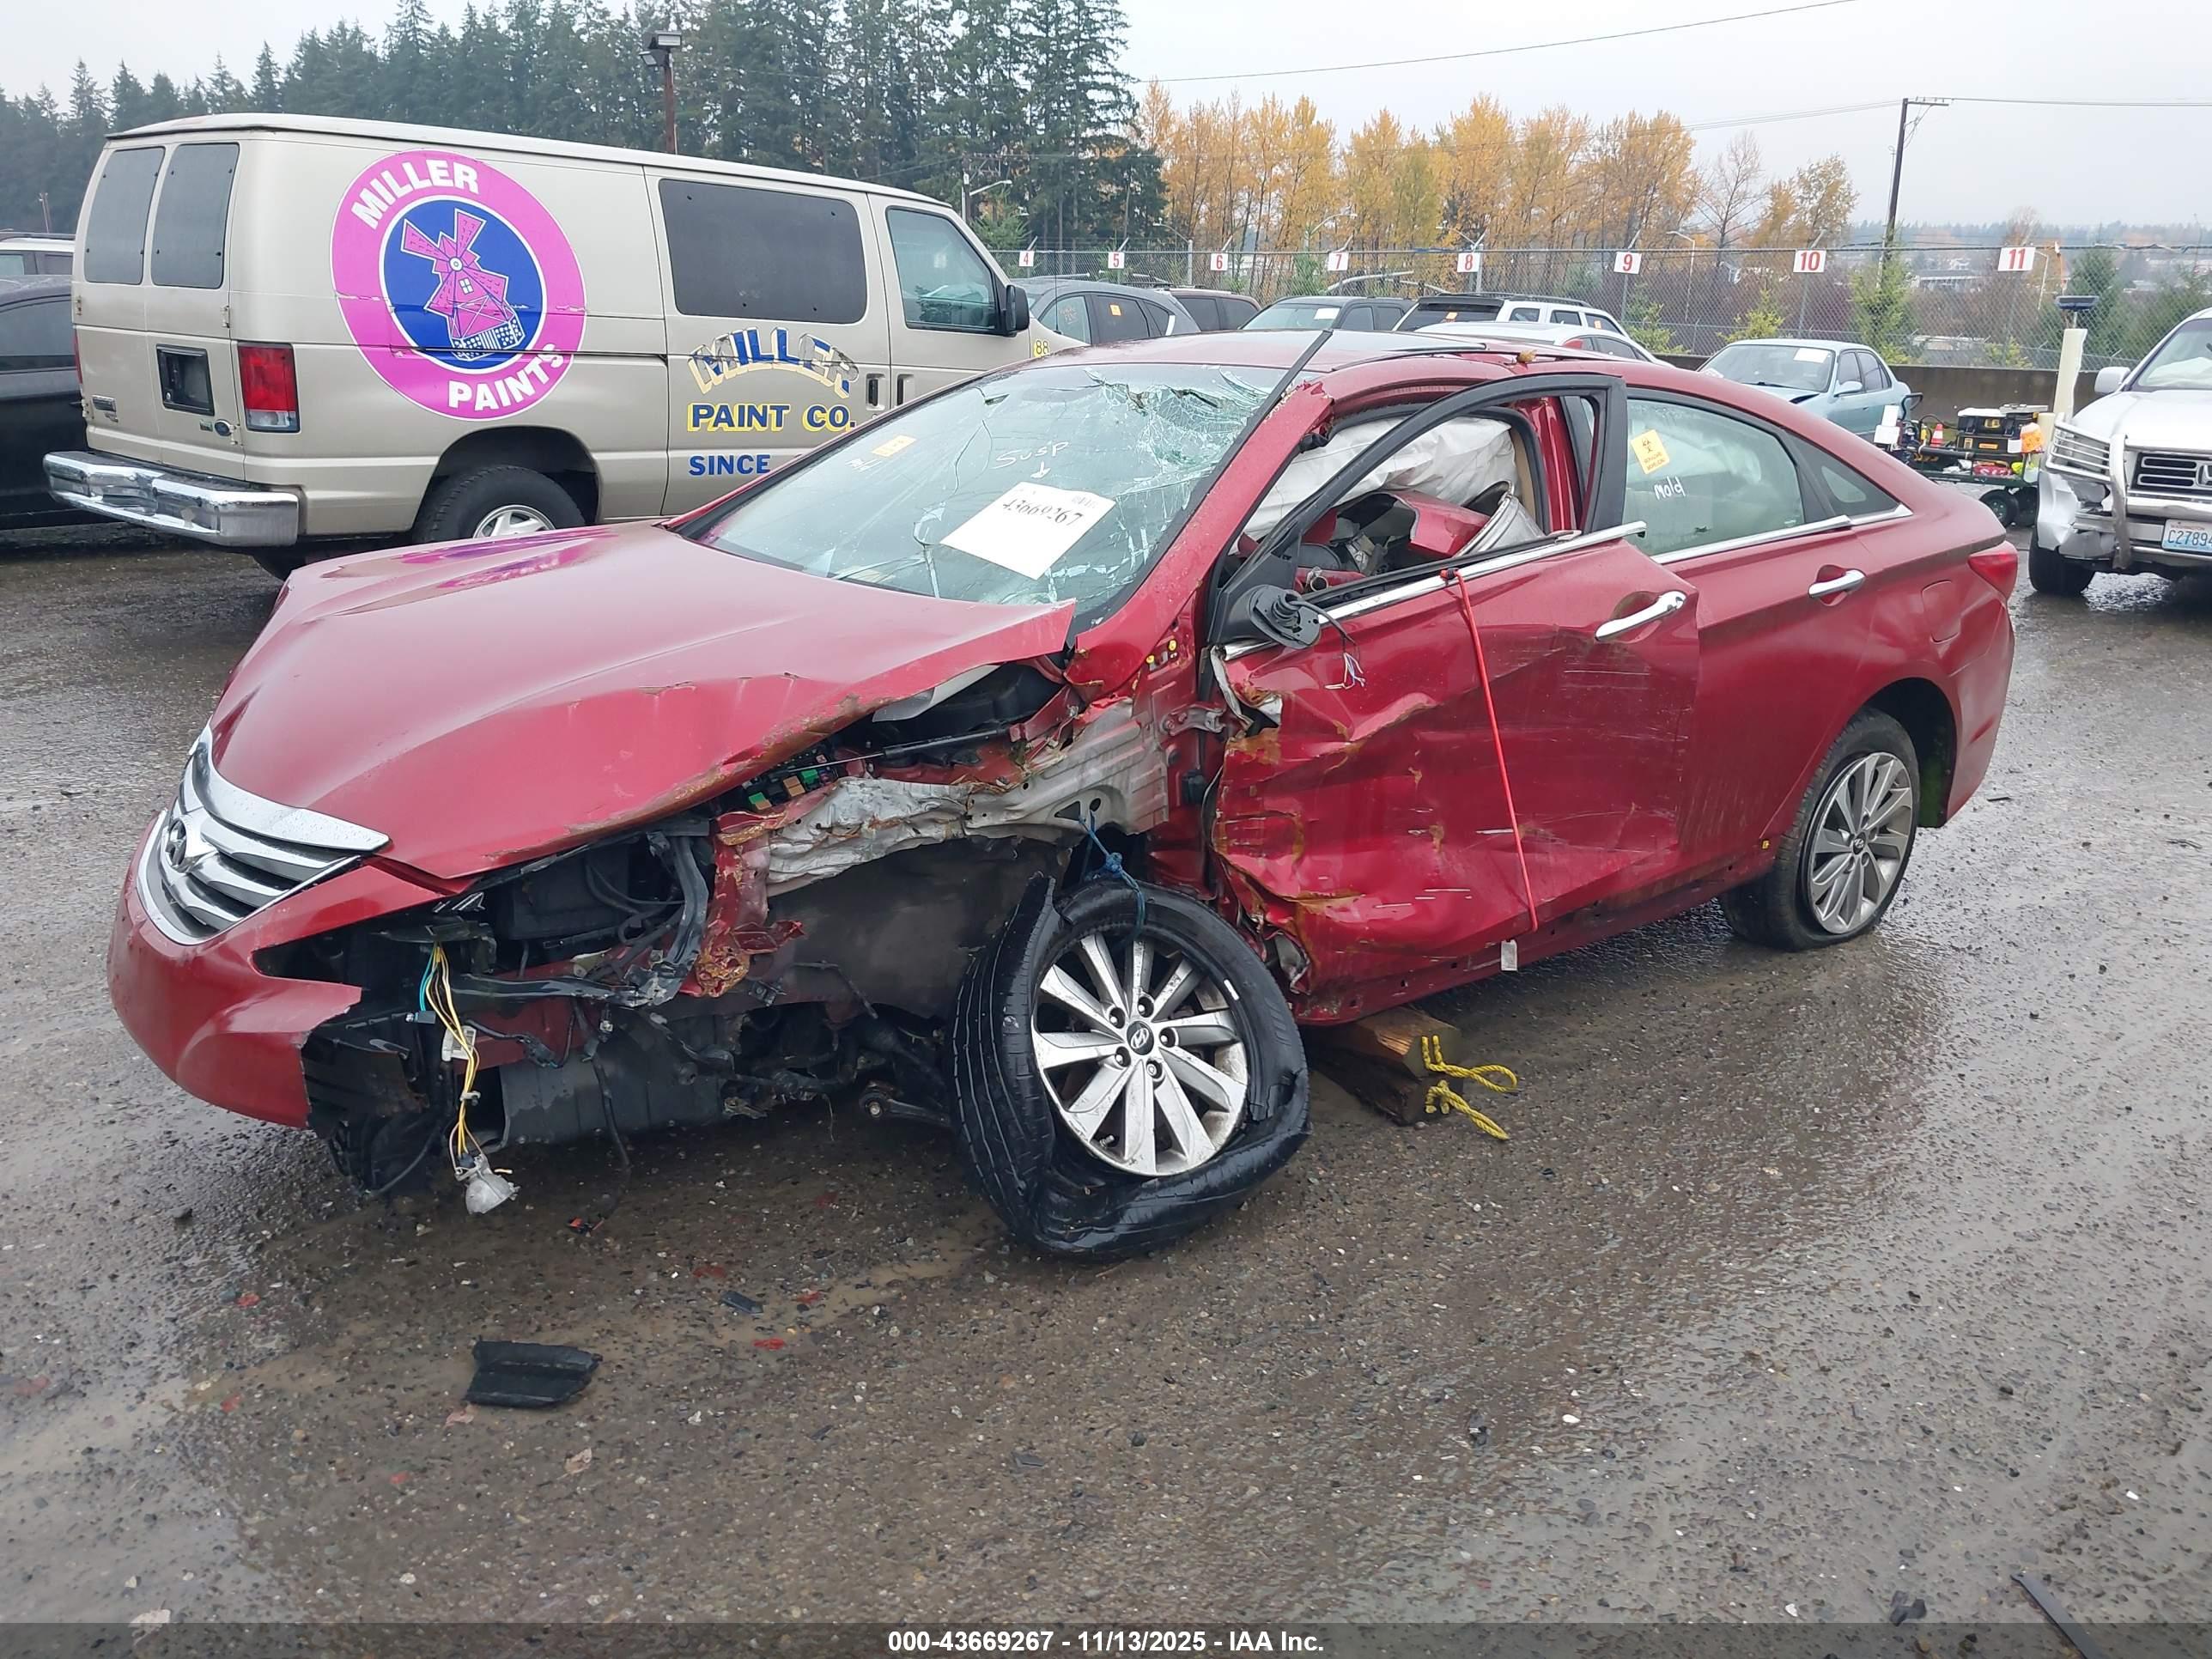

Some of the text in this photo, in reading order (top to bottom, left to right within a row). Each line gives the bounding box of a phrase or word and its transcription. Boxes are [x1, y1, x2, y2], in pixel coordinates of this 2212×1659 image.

[351, 160, 480, 230] MILLER
[1024, 252, 1030, 265] 4
[1113, 252, 1120, 267] 5
[1216, 254, 1224, 270] 6
[1335, 253, 1343, 270] 7
[1464, 253, 1474, 271] 8
[1622, 253, 1633, 271] 9
[1801, 252, 1820, 270] 10
[2009, 248, 2026, 270] 11
[688, 326, 860, 398] MILLER
[448, 343, 564, 411] PAINTS
[688, 403, 857, 432] PAINT CO.
[689, 454, 772, 476] SINCE
